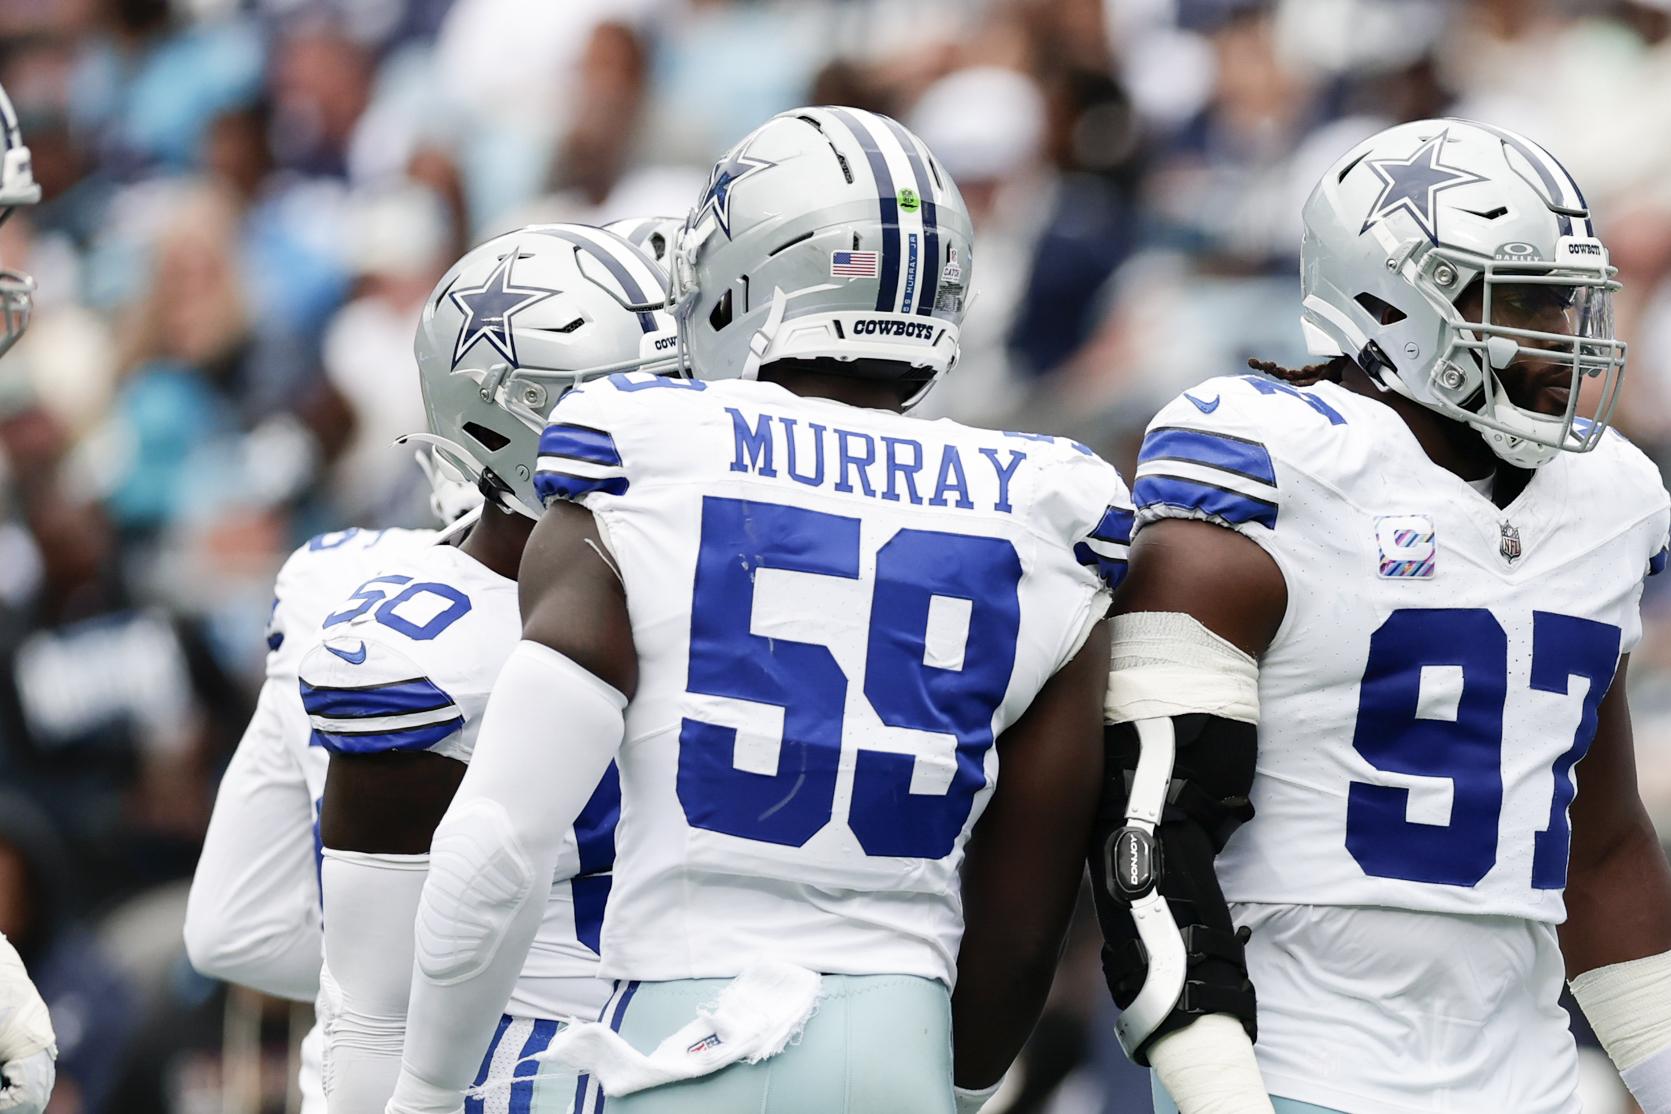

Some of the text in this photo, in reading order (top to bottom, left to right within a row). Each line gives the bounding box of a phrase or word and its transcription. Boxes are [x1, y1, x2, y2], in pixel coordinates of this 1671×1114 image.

[853, 319, 935, 341] COWBOYS
[723, 406, 1027, 514] MURRAY
[1379, 516, 1435, 562] C
[1503, 537, 1521, 556] NFL
[322, 573, 473, 641] 50
[675, 494, 1024, 860] 59
[1344, 607, 1623, 890] 97
[1130, 833, 1139, 886] DONJOY
